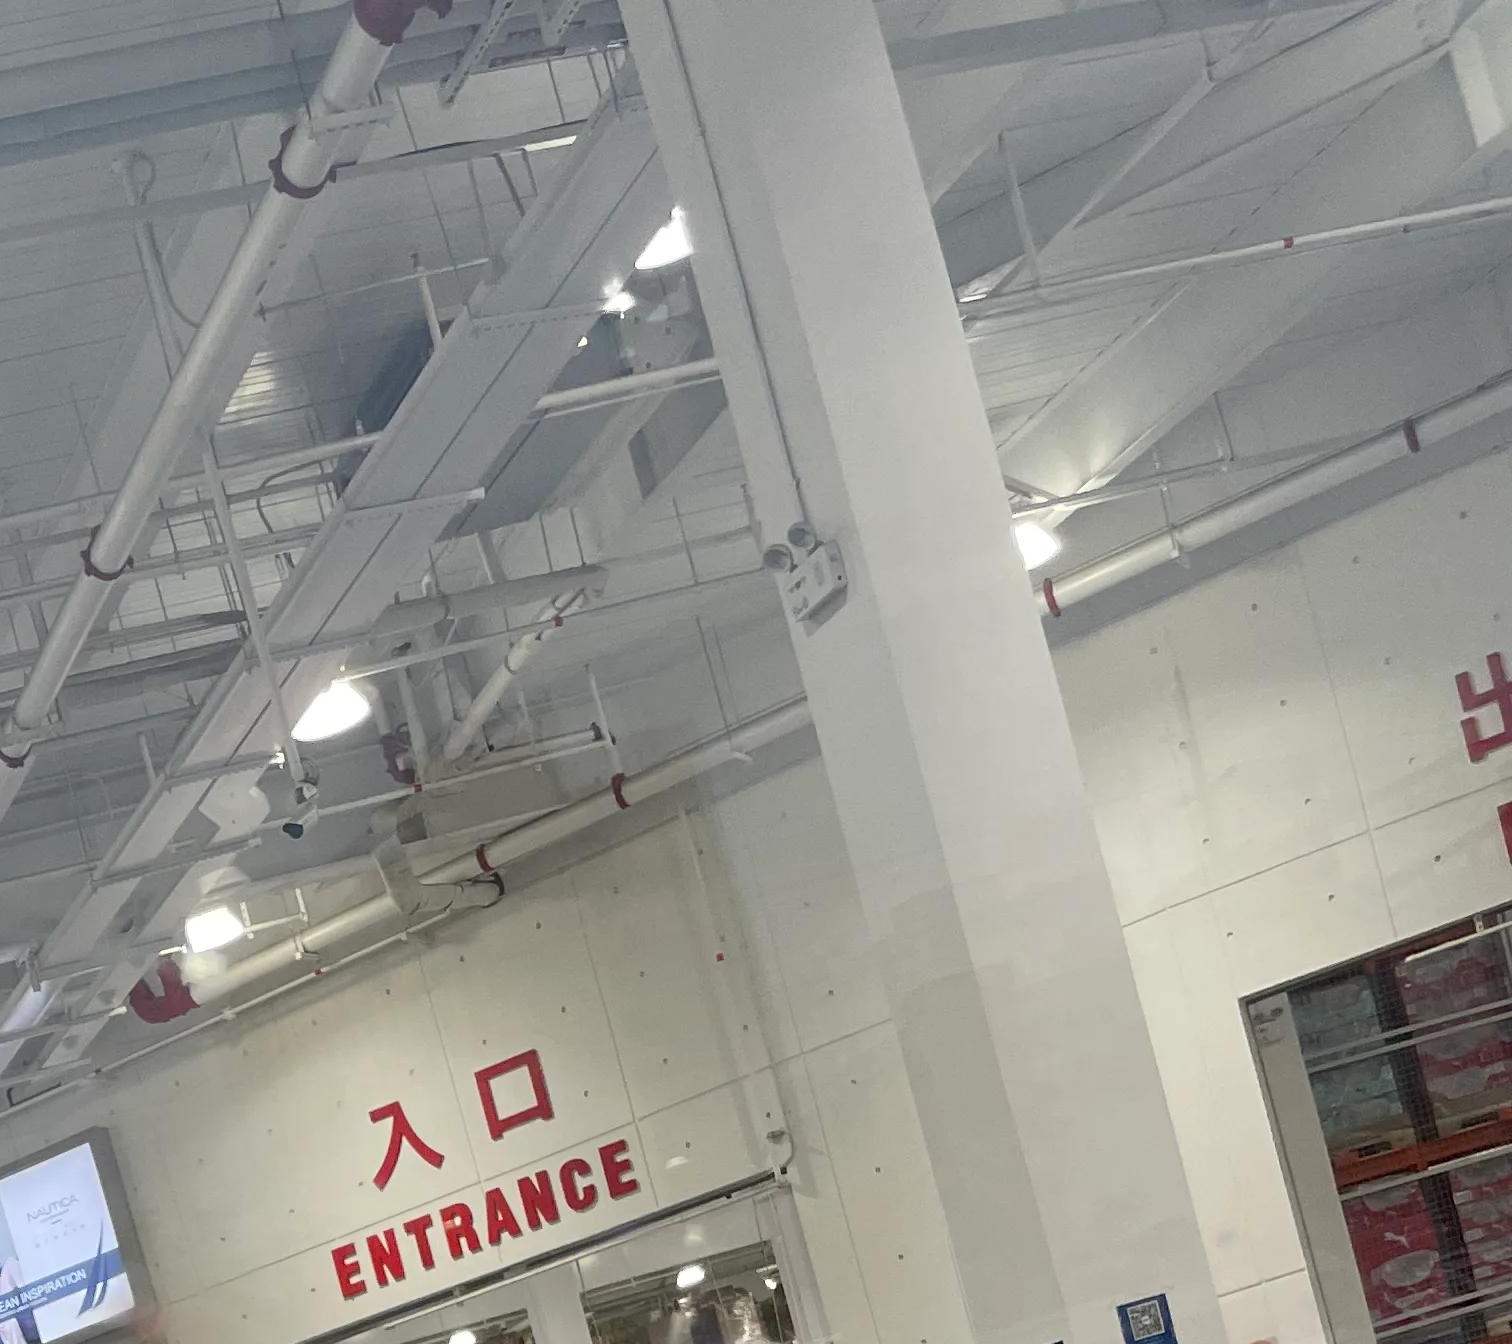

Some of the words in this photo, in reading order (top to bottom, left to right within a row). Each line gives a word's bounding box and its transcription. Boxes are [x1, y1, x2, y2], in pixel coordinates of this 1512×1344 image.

[368, 1048, 555, 1193] 入口
[26, 1194, 79, 1223] NAUTICA
[331, 1138, 641, 1302] ENTRANCE
[20, 1268, 87, 1304] INSPIRATION
